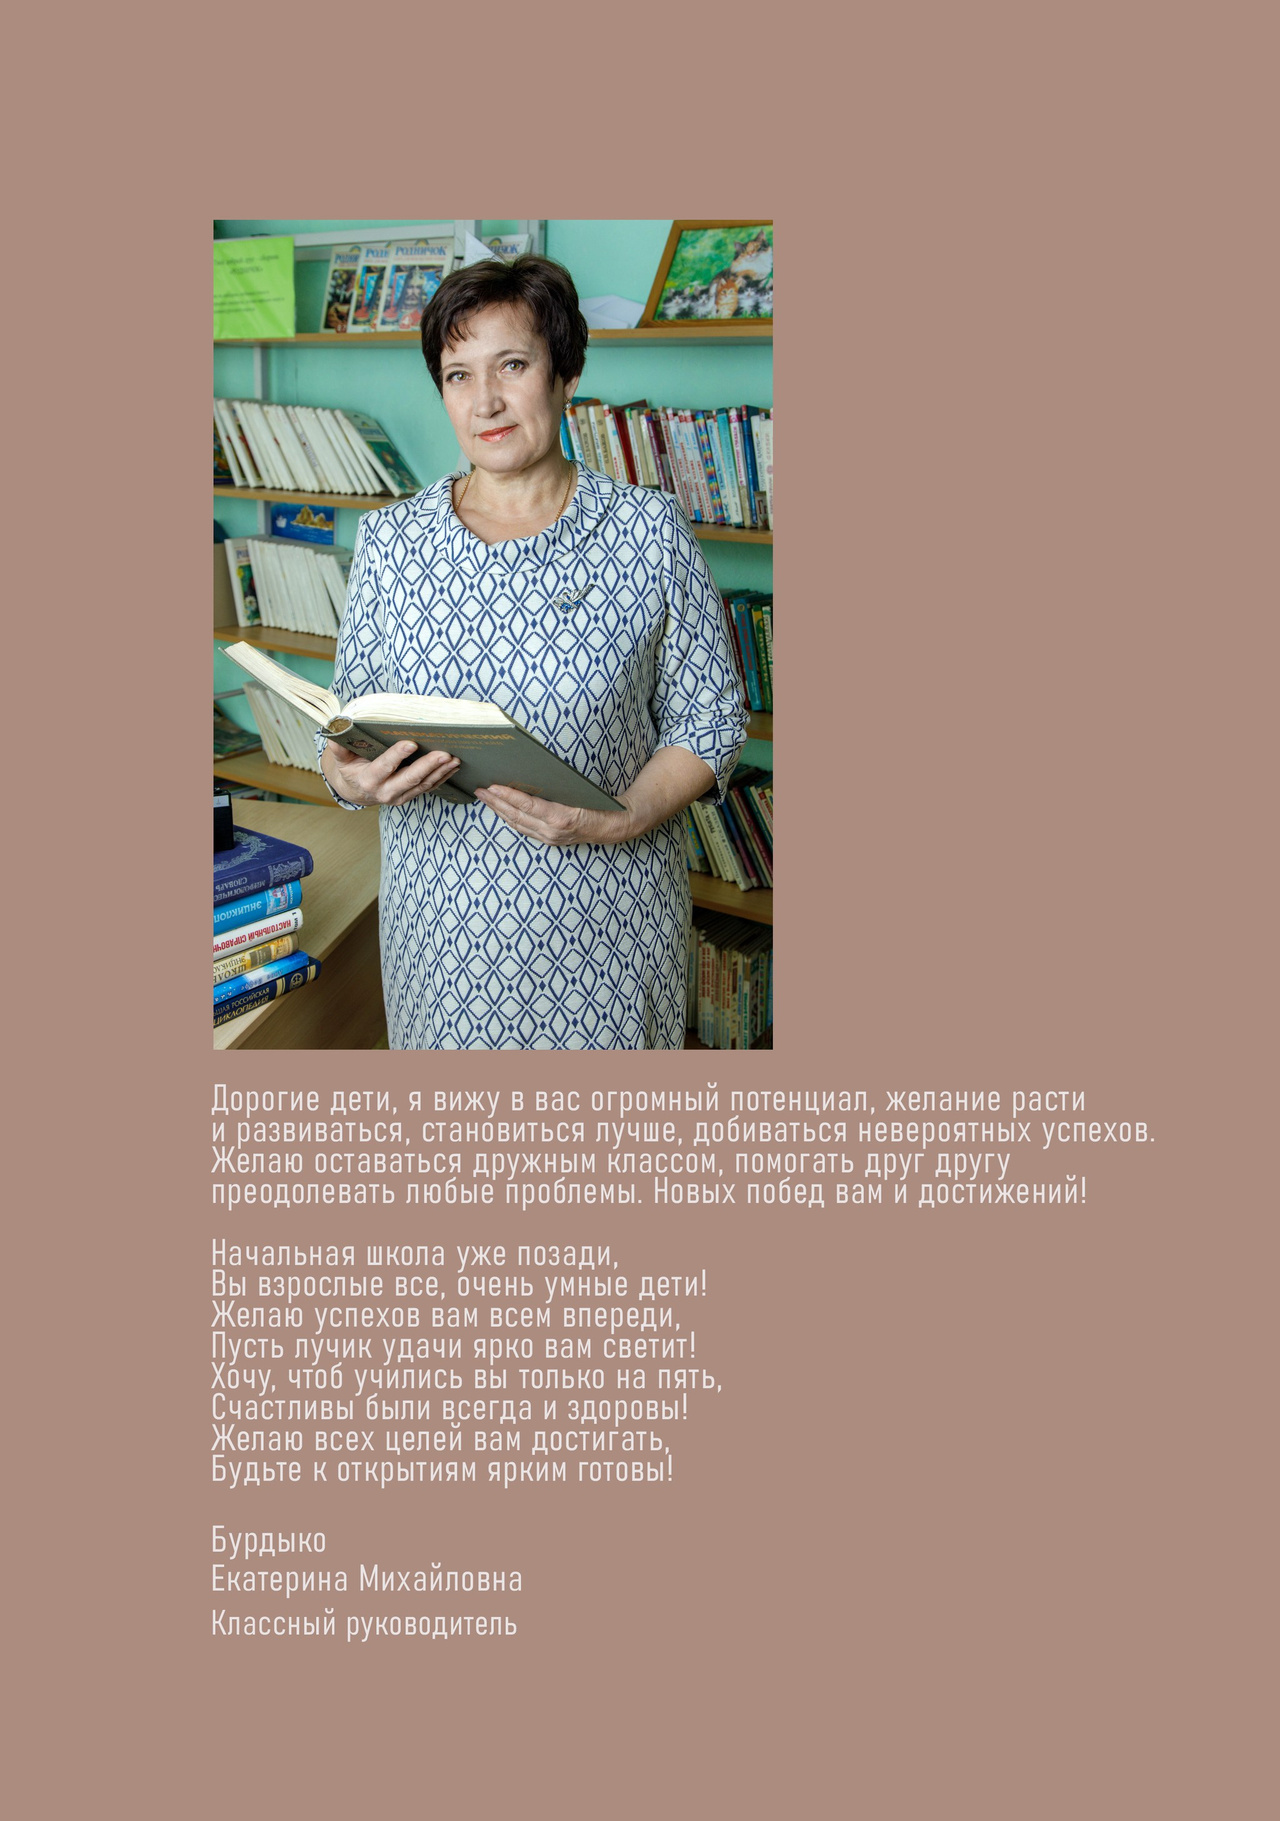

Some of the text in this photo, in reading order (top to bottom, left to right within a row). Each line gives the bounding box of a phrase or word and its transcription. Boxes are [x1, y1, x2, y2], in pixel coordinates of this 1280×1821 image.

[215, 876, 248, 891] СЛОВАРЬ
[248, 919, 292, 942] НАСТОЛЬНЫЙ
[213, 994, 270, 1026] ЦИКЛОПЕДИЯ
